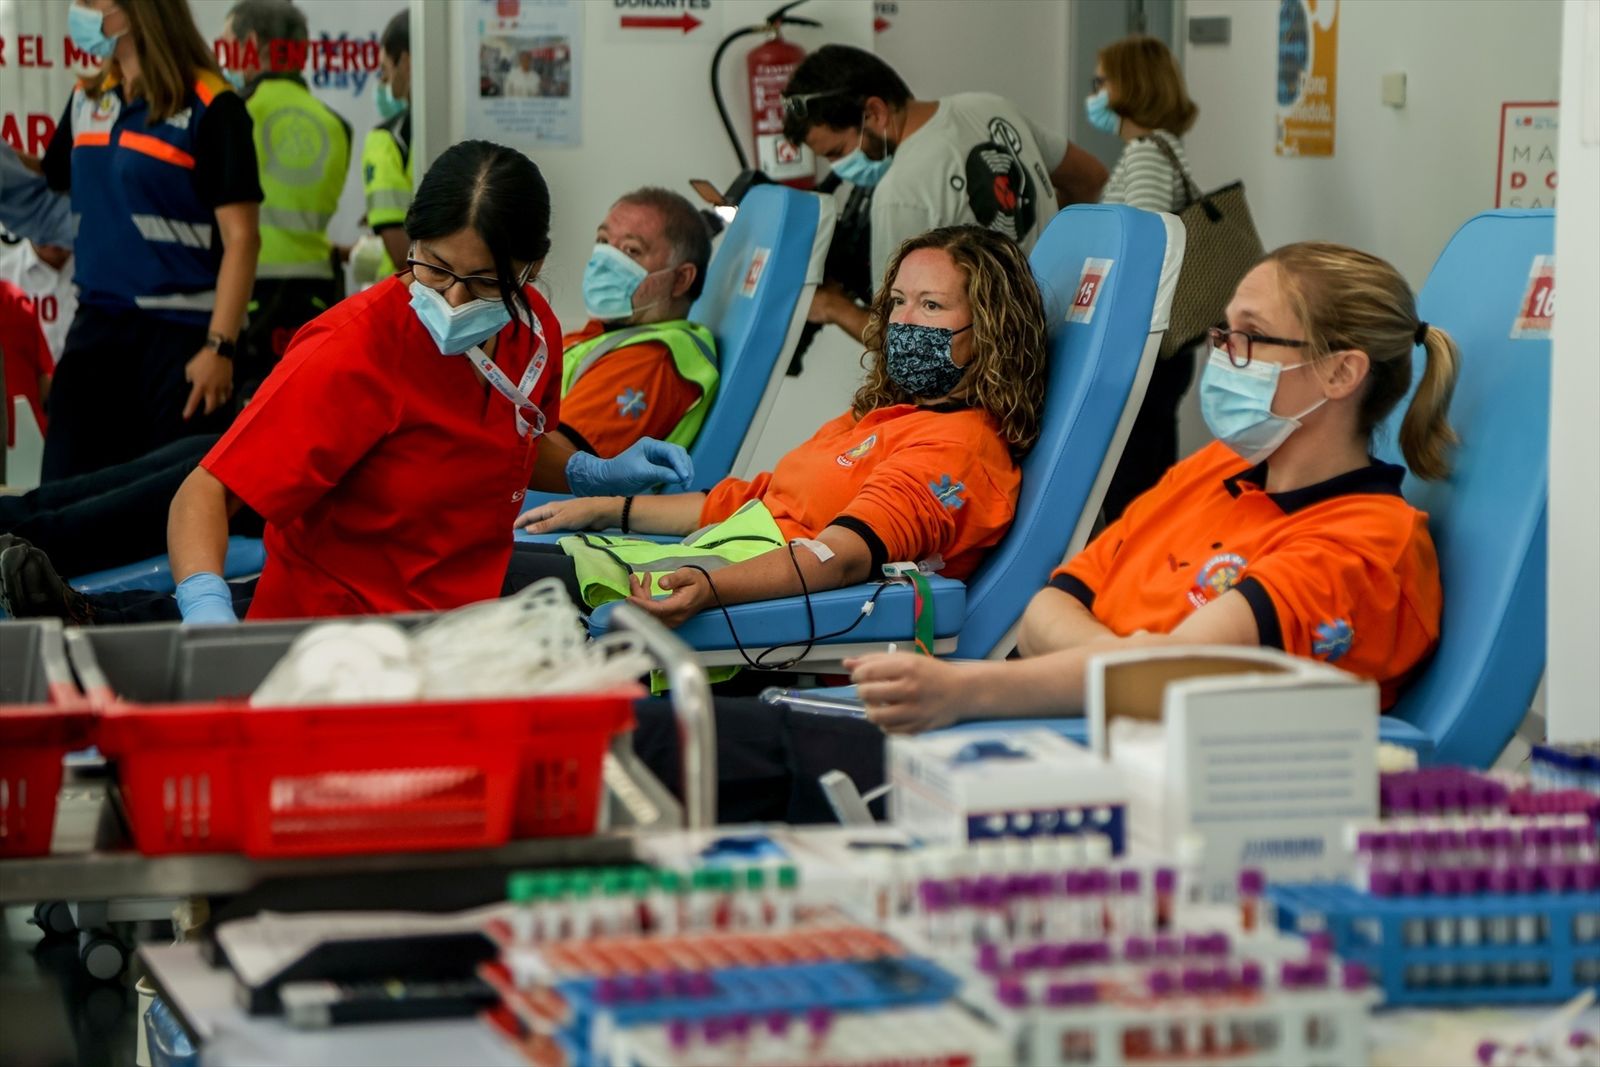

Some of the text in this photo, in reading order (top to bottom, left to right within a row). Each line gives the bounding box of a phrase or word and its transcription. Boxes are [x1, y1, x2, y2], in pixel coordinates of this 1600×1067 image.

[18, 35, 53, 68] EL
[269, 39, 380, 72] ENTERO
[1078, 282, 1095, 304] 15
